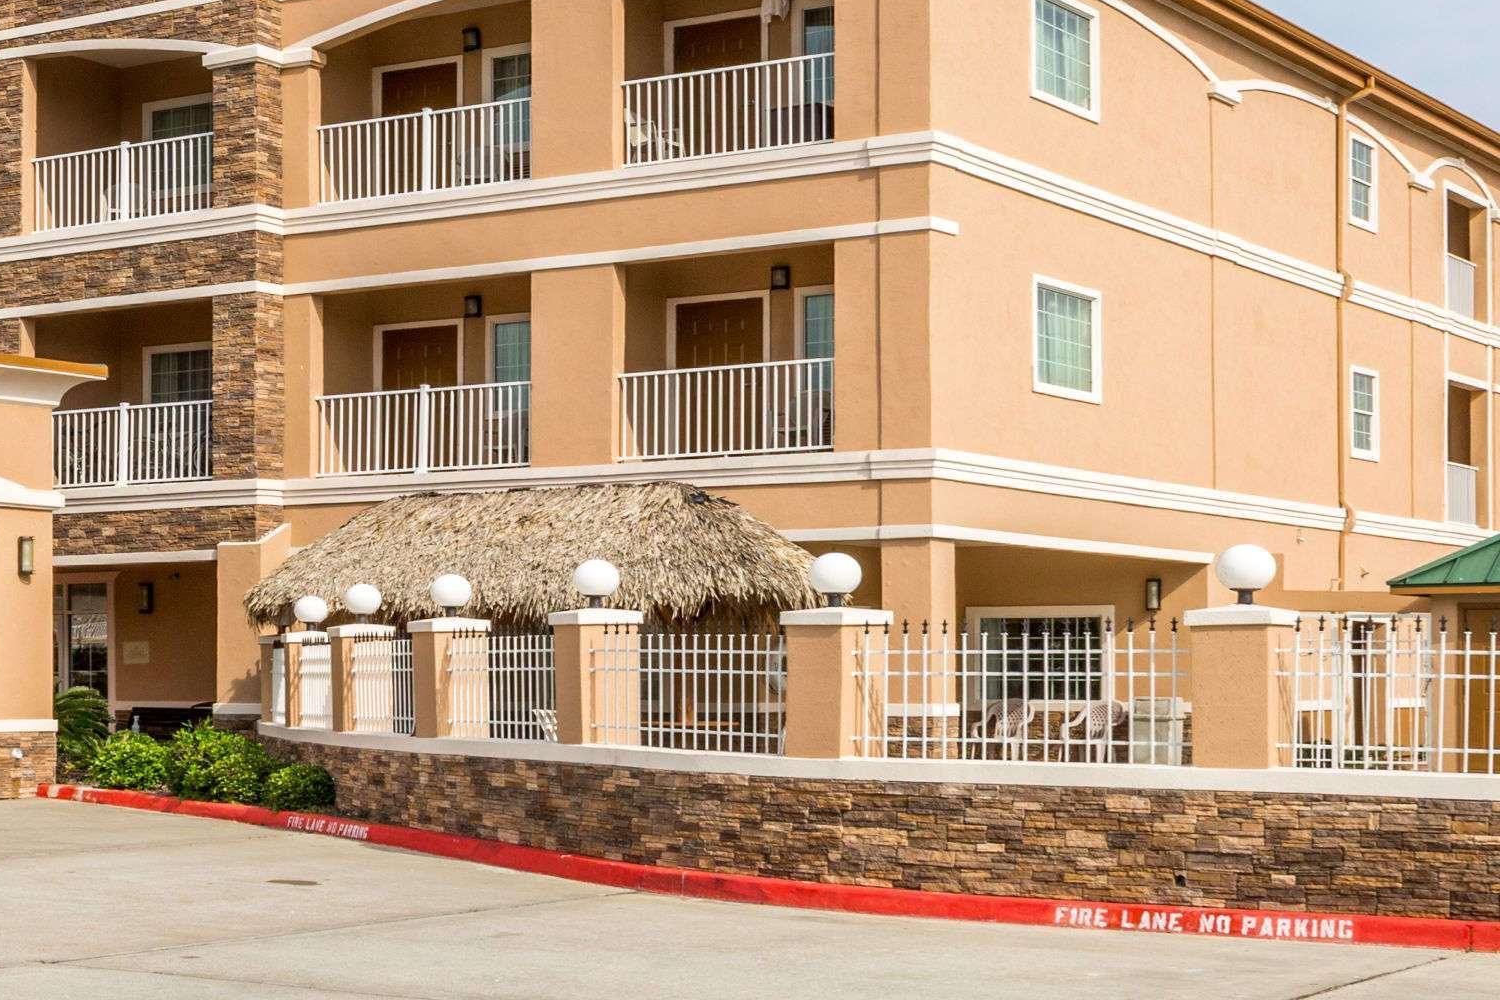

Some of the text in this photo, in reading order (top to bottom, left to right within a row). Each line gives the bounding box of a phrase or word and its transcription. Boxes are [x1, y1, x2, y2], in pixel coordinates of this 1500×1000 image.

[1054, 906, 1354, 939] FIRE LANE NO PARKING
